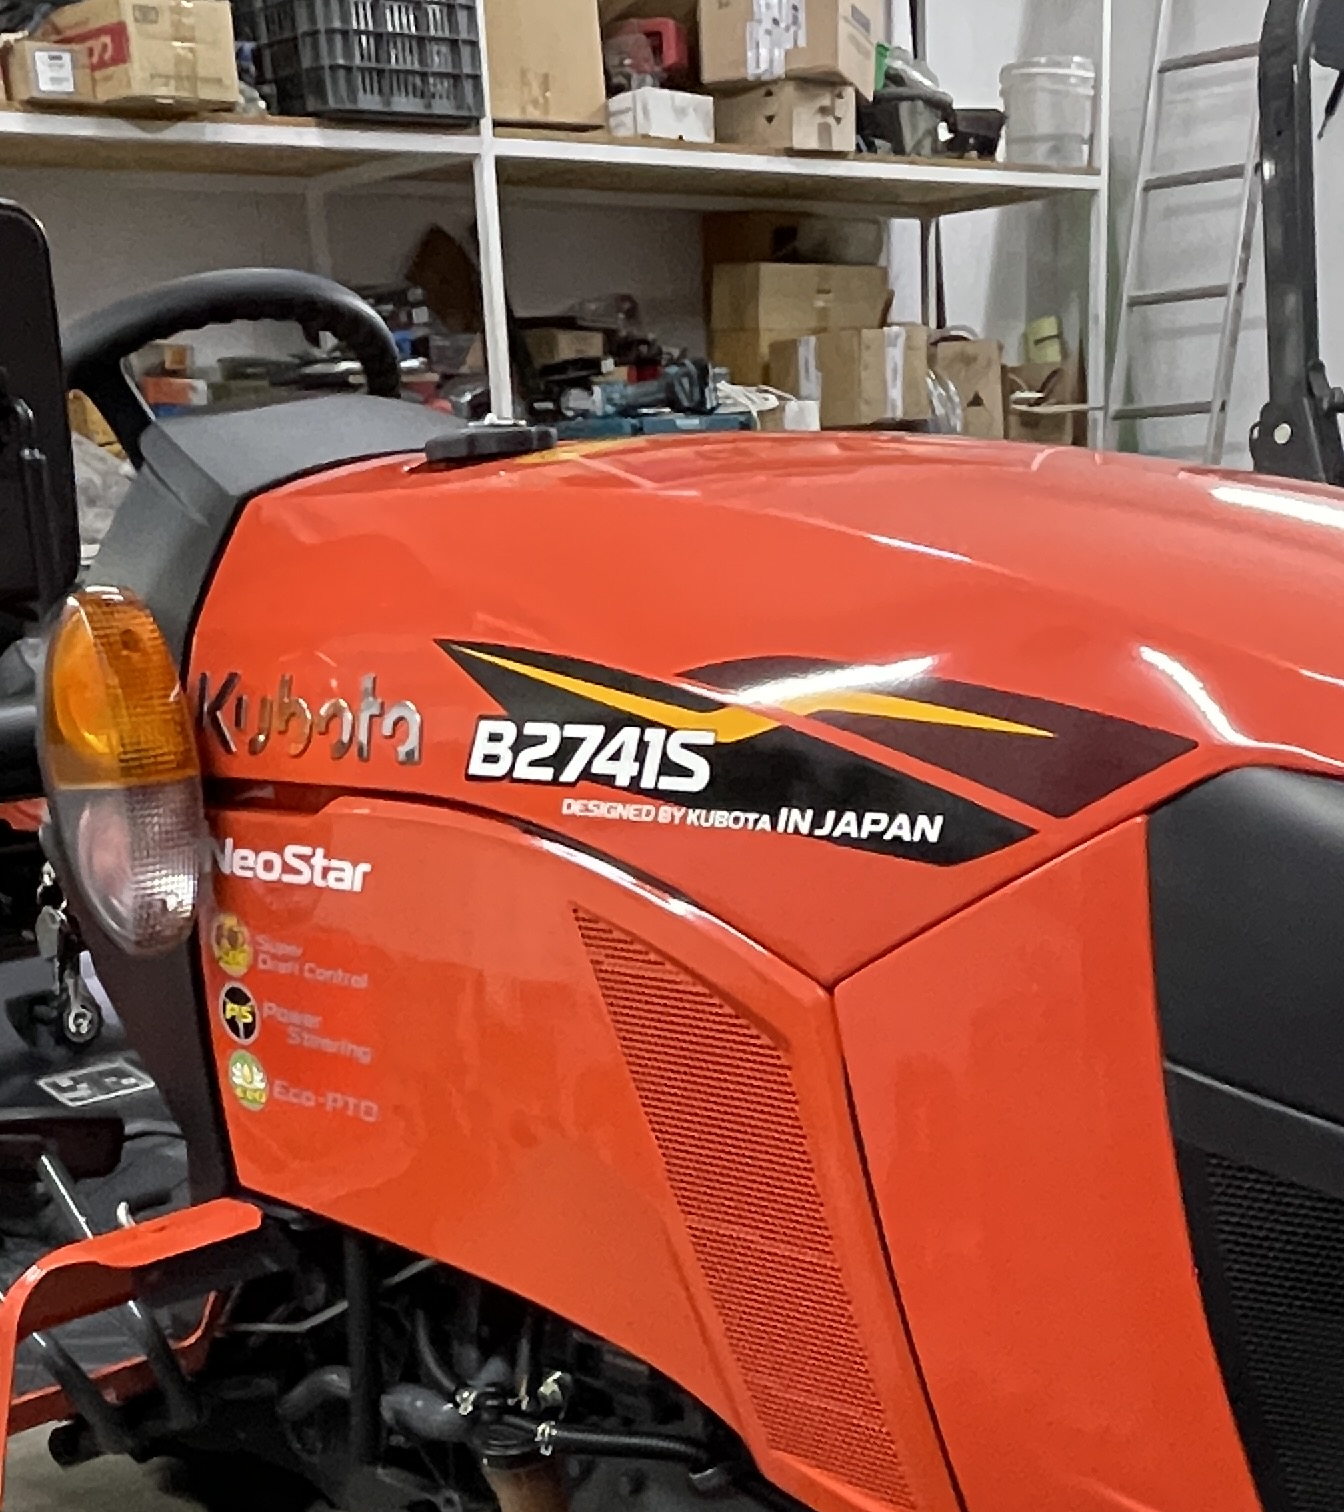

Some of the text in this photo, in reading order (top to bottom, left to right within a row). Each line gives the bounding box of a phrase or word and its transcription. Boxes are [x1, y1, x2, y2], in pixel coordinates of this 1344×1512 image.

[196, 671, 422, 765] Kubota
[467, 718, 717, 793] B2741S
[561, 798, 944, 843] DESIGNED BY KUBOTA IN JAPAN
[304, 962, 368, 988] Control
[262, 1001, 322, 1028] Power
[272, 1079, 379, 1122] Eco-PTO
